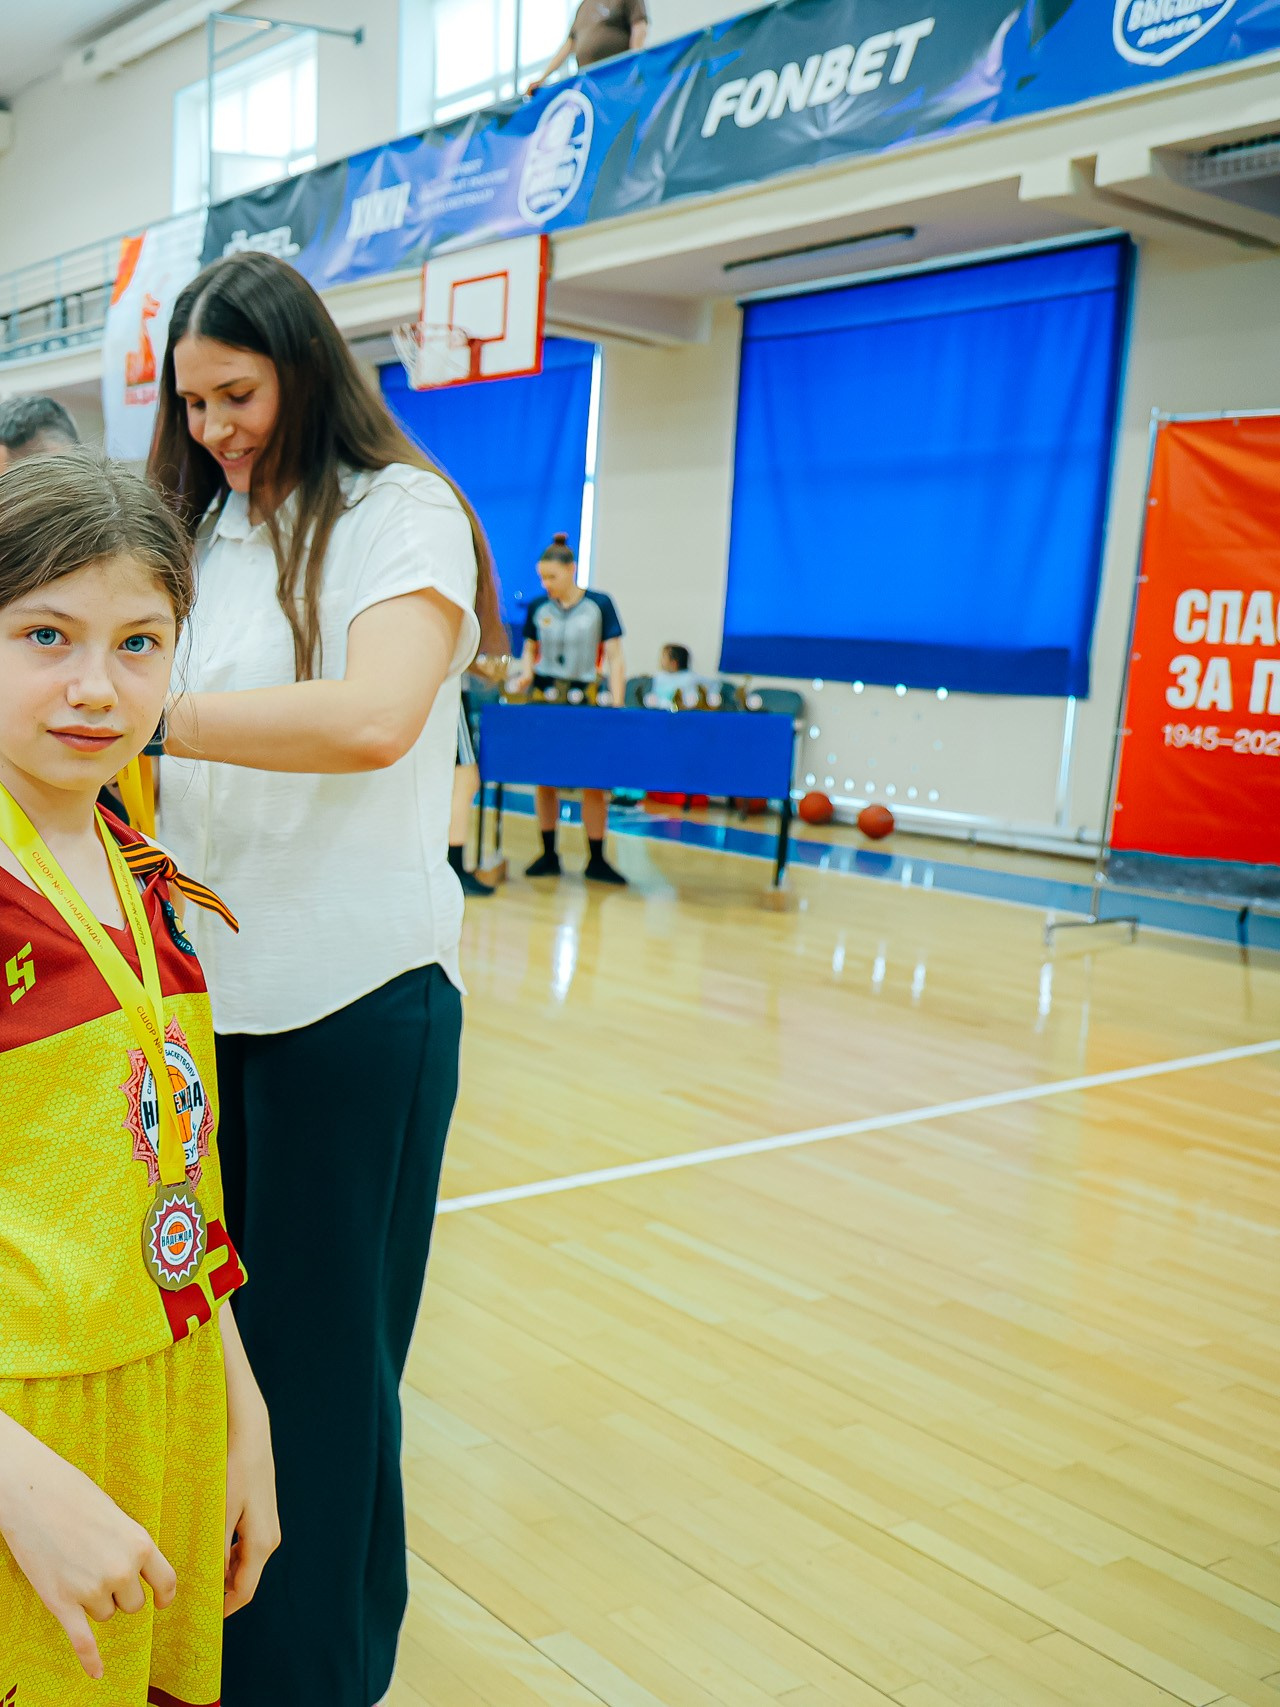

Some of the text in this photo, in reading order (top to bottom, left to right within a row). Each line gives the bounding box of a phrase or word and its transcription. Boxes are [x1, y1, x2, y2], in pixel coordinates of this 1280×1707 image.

[701, 16, 935, 138] FONBET
[1173, 588, 1280, 646] СПА
[1165, 655, 1233, 712] ЗА
[31, 850, 54, 880] СШОР
[136, 1005, 163, 1055] СШОР №5
[142, 1081, 203, 1130] НЕЖДА
[161, 1229, 192, 1248] НАДЕЖДА
